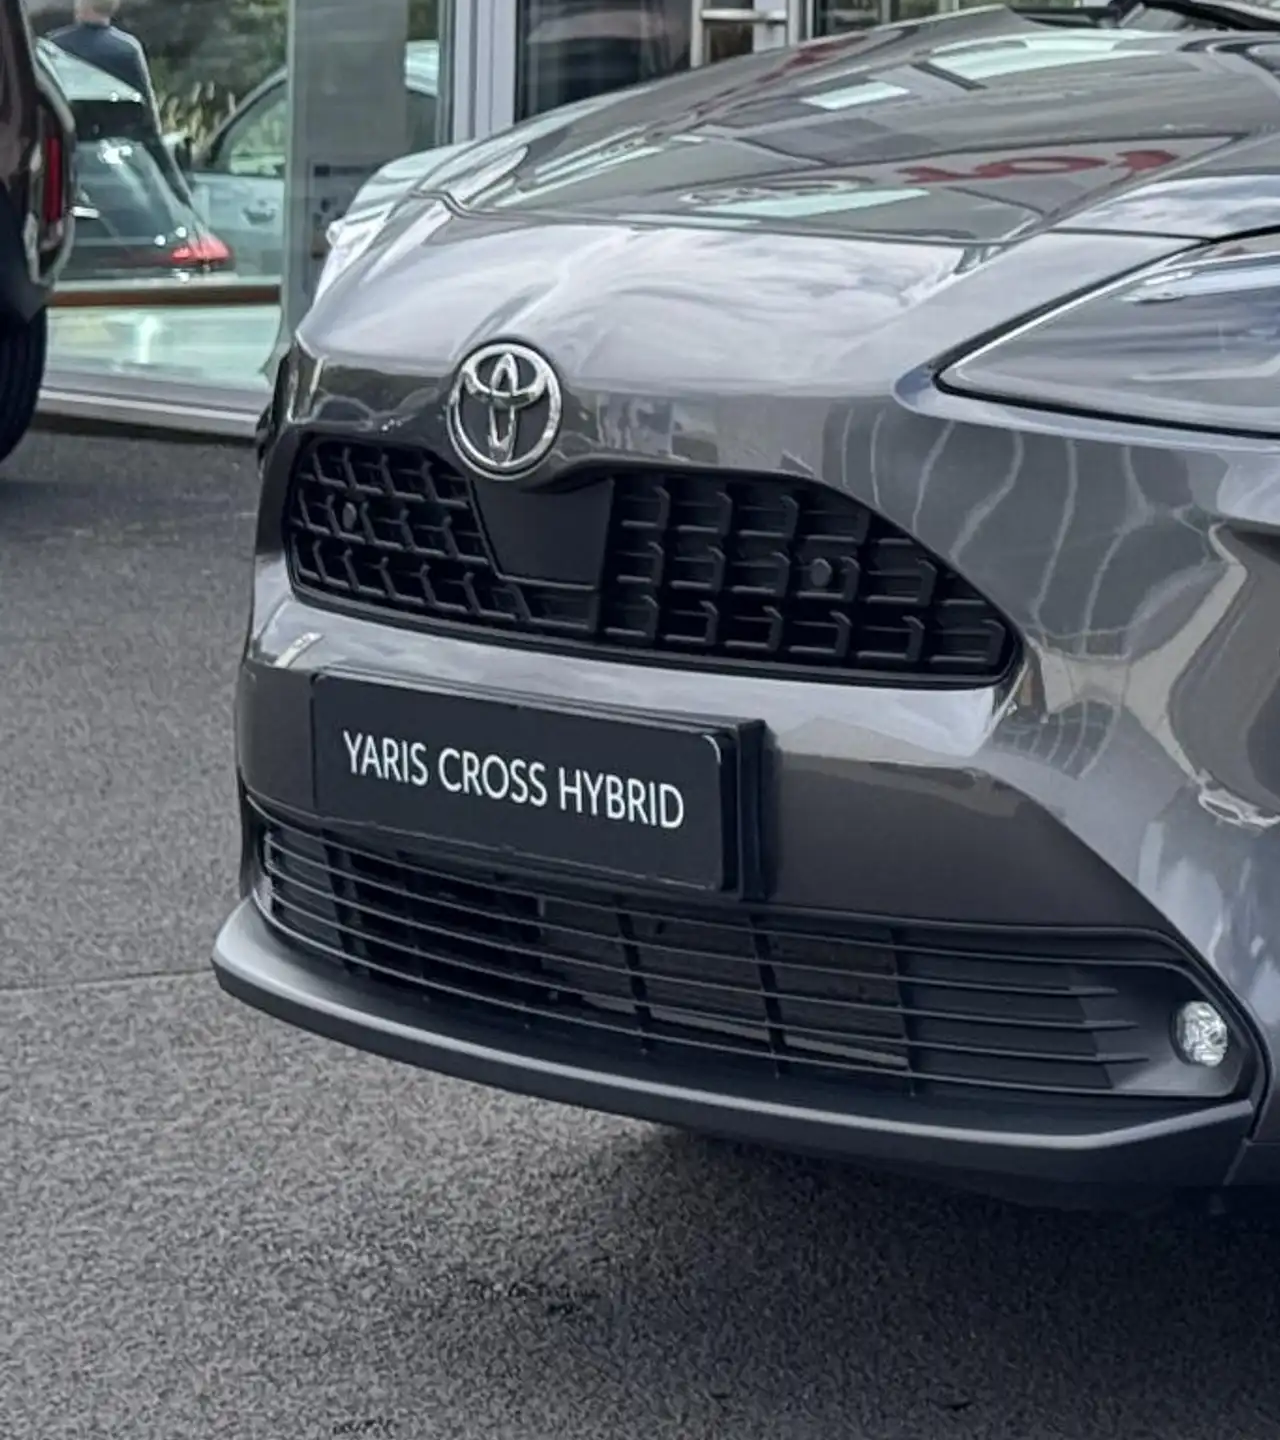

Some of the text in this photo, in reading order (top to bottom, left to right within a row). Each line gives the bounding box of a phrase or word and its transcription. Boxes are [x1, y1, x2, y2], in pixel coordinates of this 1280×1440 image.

[342, 730, 684, 829] YARIS CROSS HYBRID
